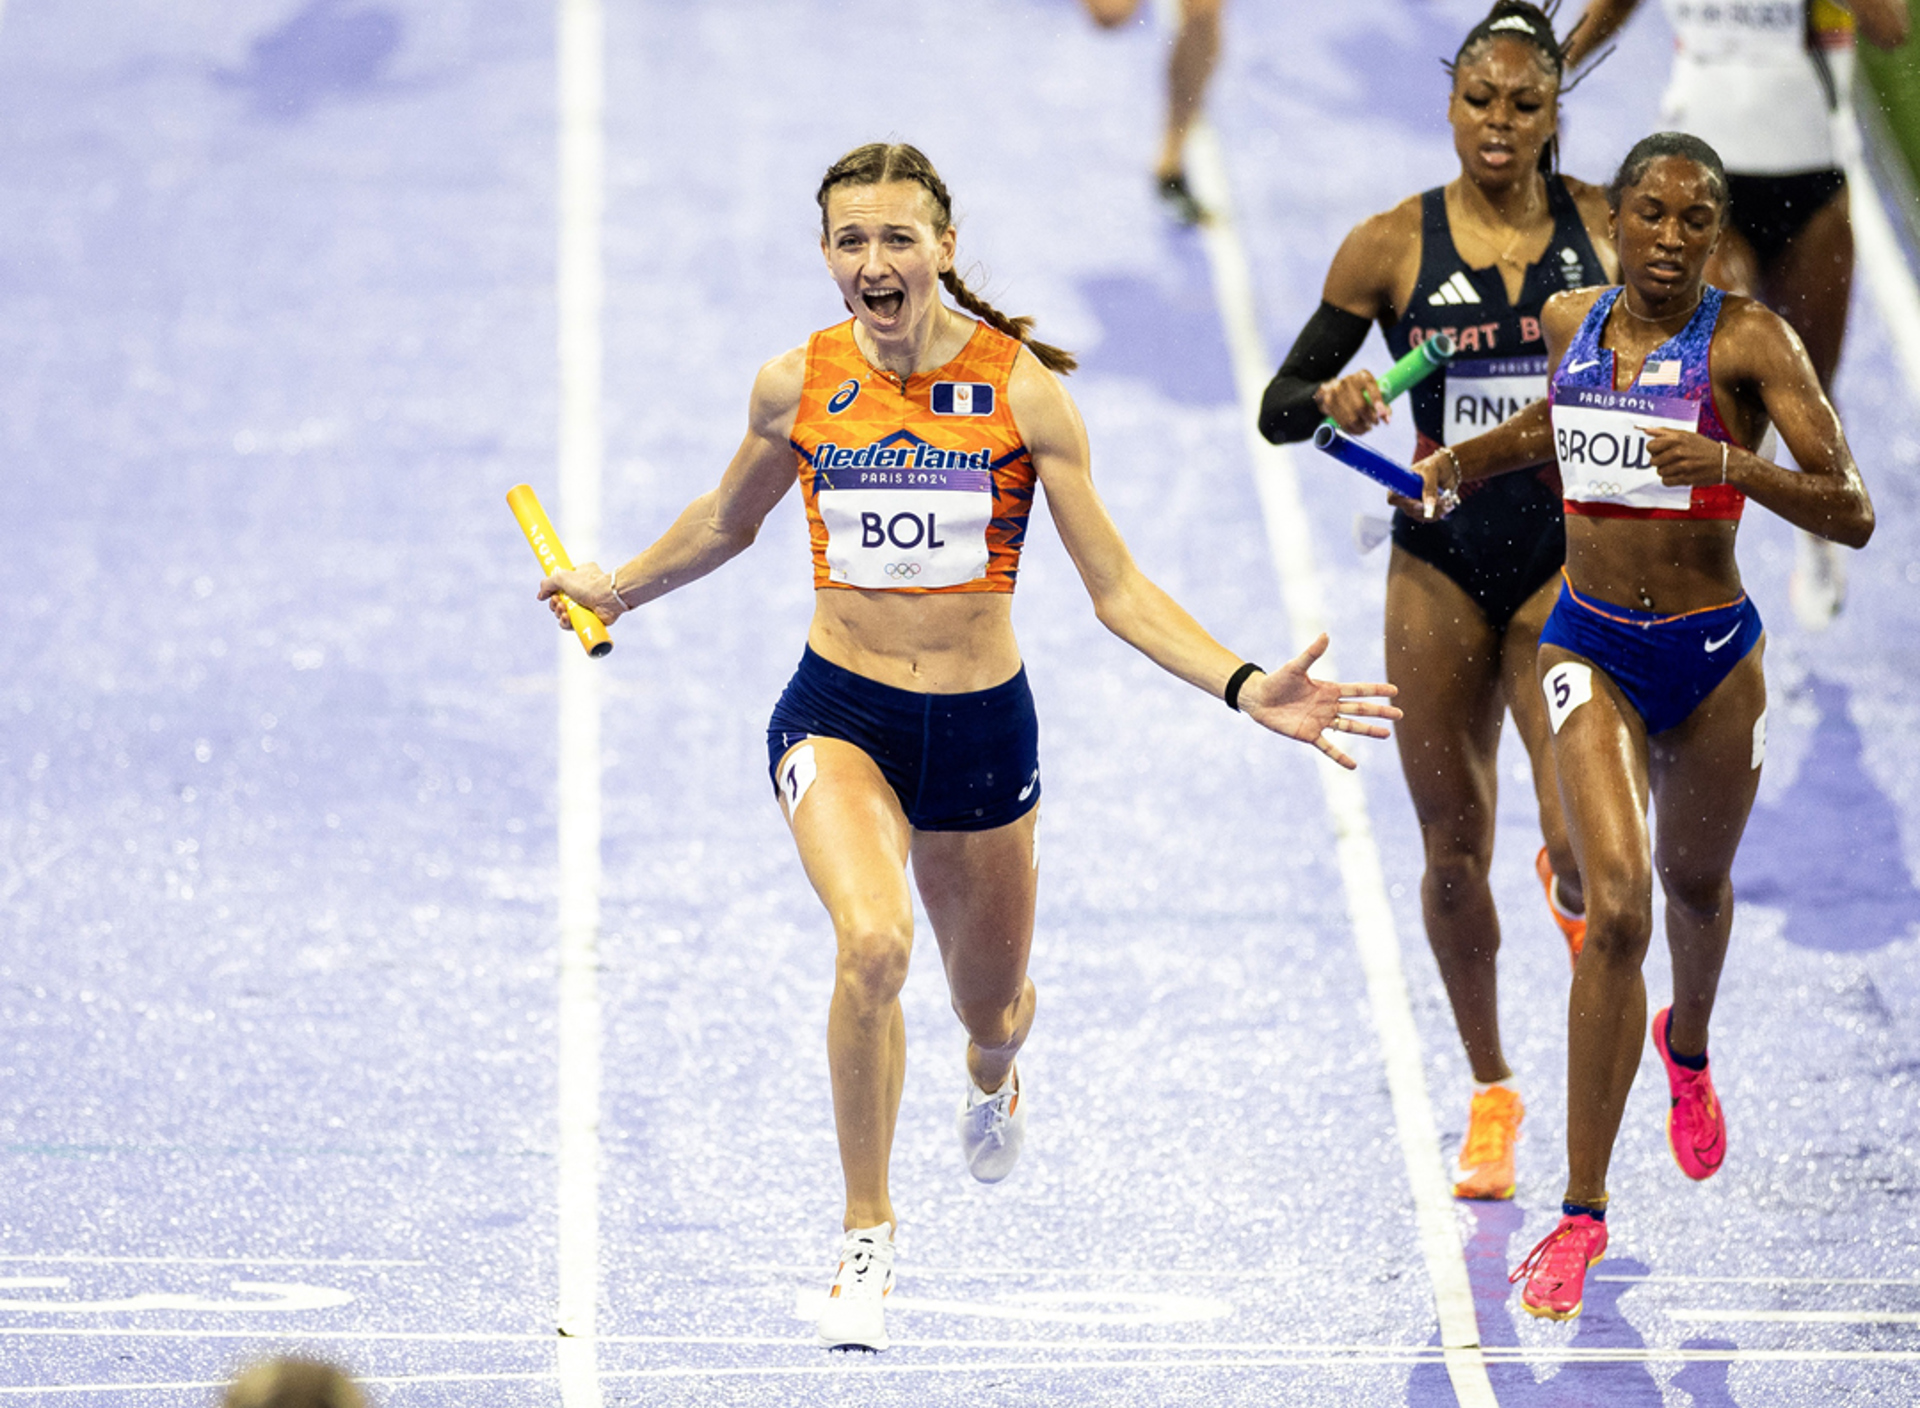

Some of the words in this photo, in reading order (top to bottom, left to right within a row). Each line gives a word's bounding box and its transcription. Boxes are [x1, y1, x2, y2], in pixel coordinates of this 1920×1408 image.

[1520, 316, 1541, 342] B
[1489, 360, 1530, 374] PARIS
[1455, 394, 1531, 426] ANN
[1579, 391, 1616, 406] PARIS
[1618, 396, 1655, 411] 2024
[1558, 428, 1652, 470] BROW
[860, 473, 903, 484] PARIS
[907, 473, 948, 485] 2024
[860, 511, 945, 550] BOL
[1552, 671, 1571, 709] 5
